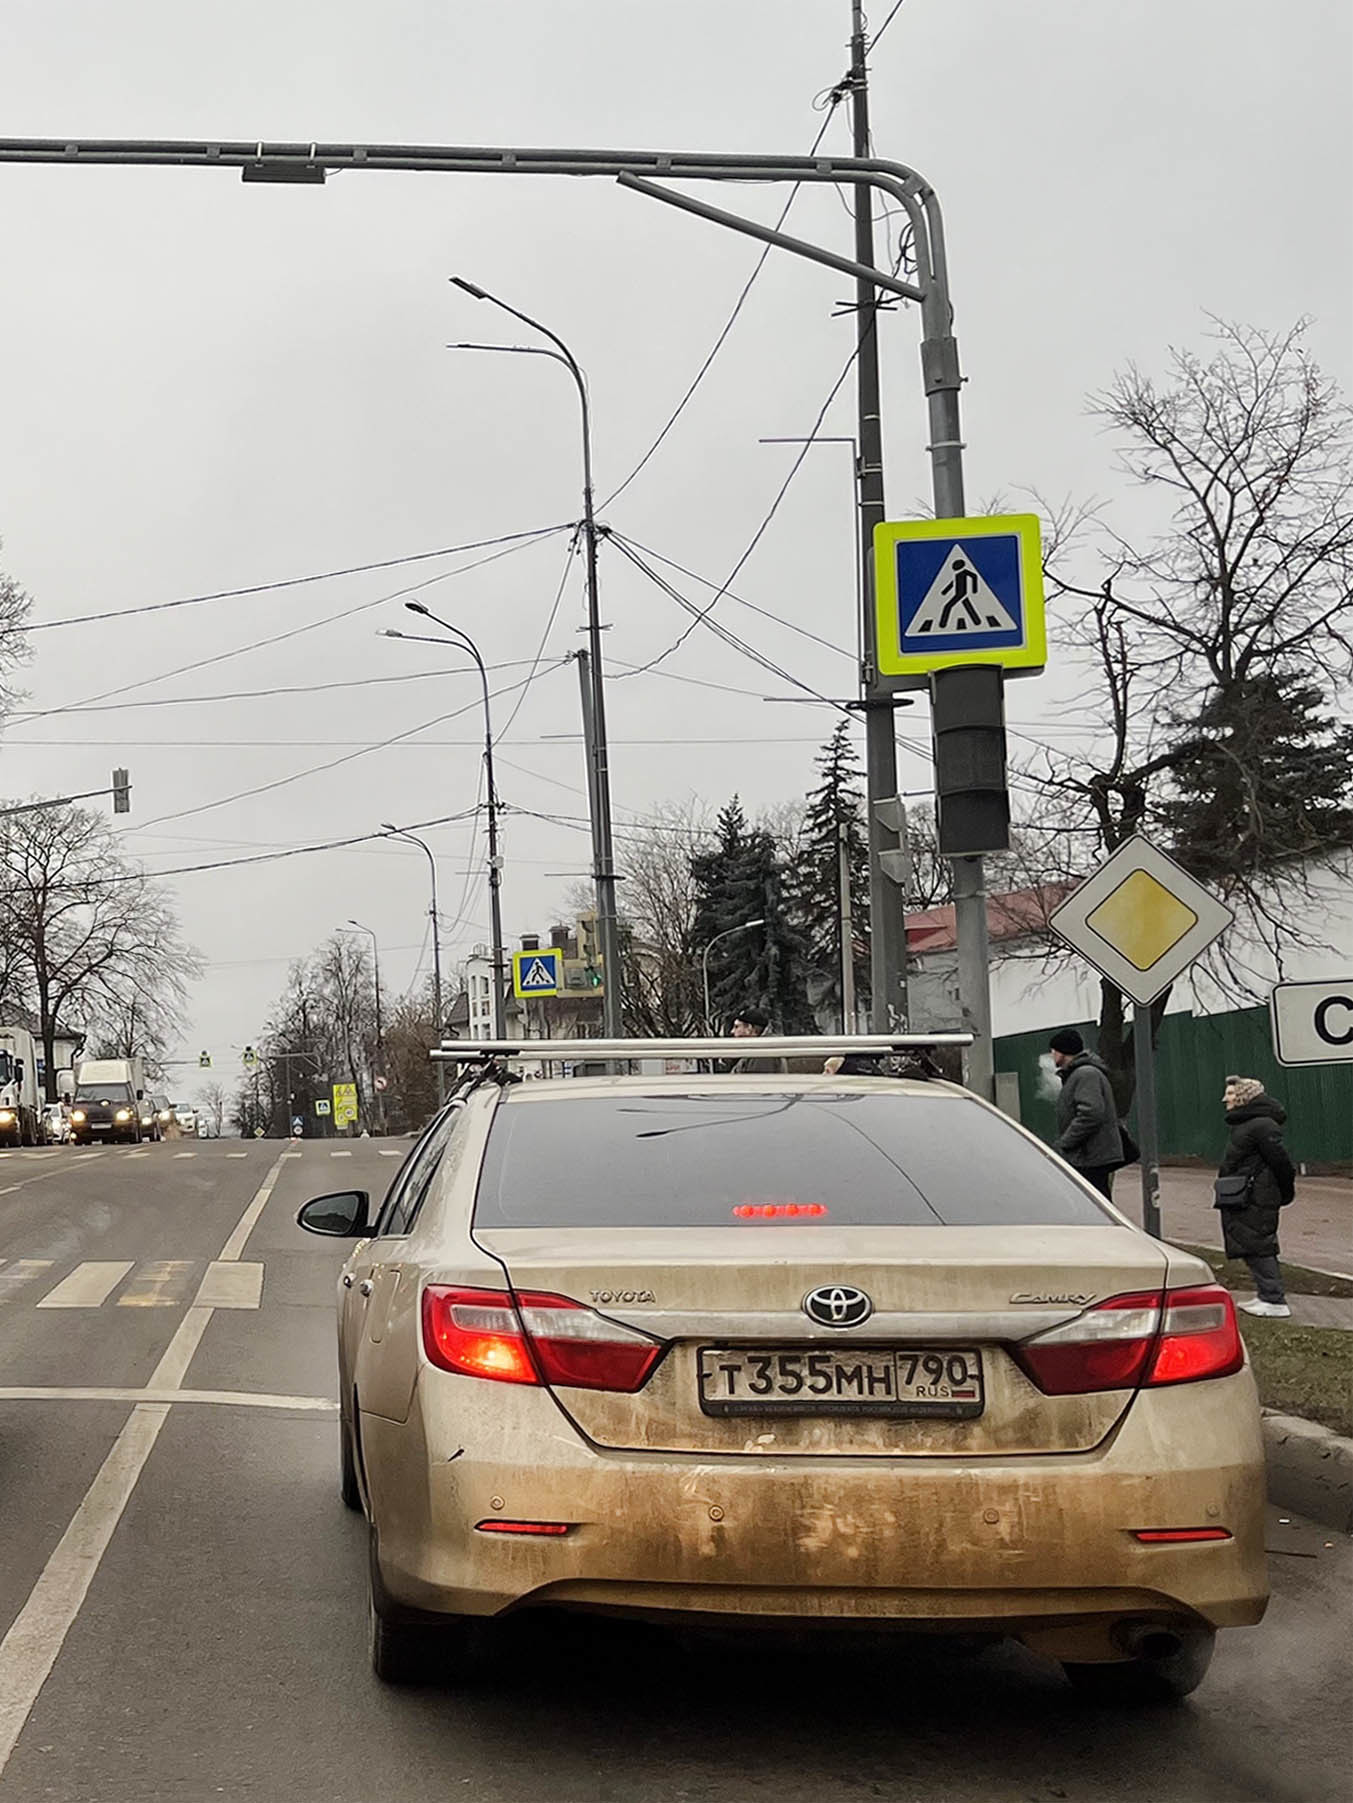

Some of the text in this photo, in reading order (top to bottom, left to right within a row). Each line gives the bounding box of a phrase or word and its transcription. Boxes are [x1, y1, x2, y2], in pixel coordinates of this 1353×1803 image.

[589, 1289, 657, 1304] TOYOTA
[719, 1354, 968, 1395] Т355МН 790
[916, 1386, 950, 1398] RUS
